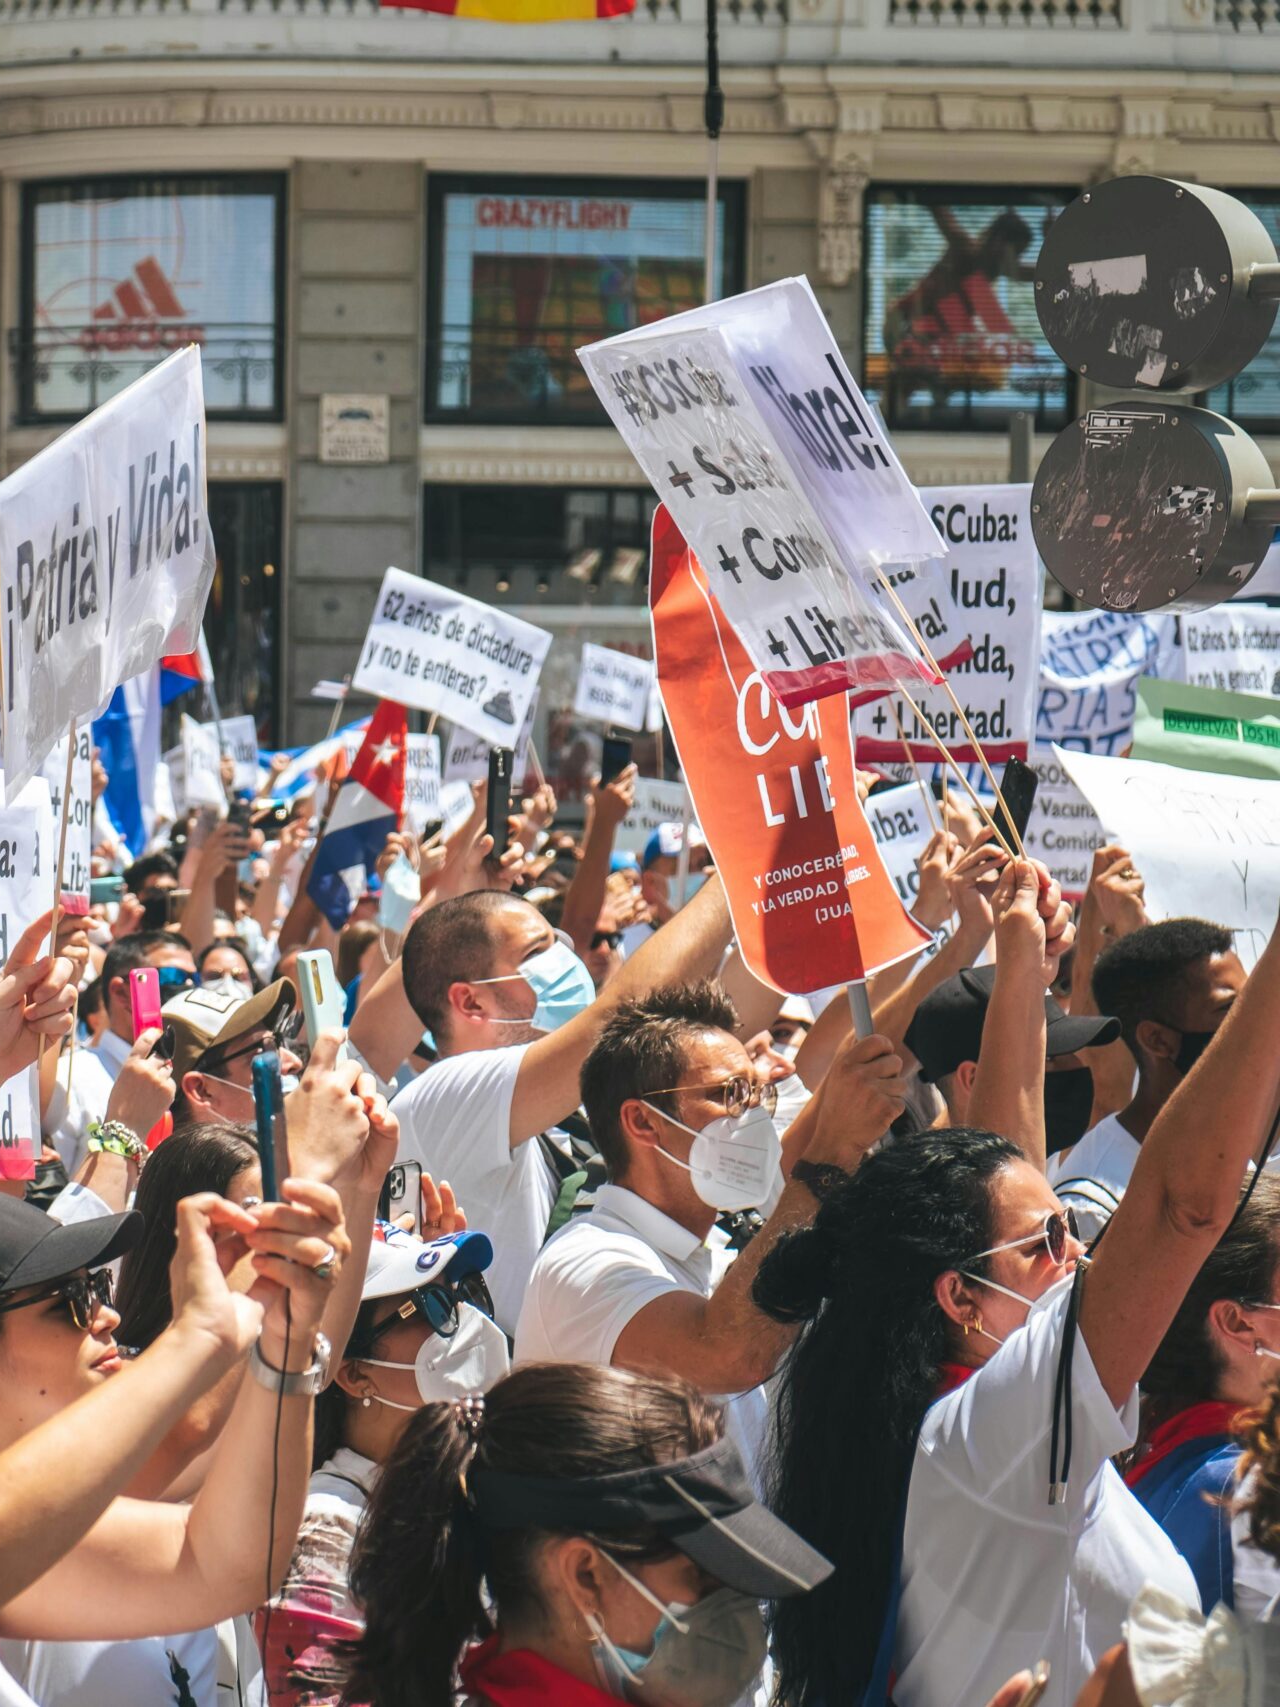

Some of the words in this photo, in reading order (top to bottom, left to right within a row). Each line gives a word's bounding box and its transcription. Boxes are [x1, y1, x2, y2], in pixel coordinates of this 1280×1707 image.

[104, 507, 121, 637] y
[128, 423, 200, 580] Vida!
[383, 589, 405, 622] 62
[403, 600, 440, 637] años
[444, 615, 466, 644] de
[466, 626, 534, 677] dictadura
[362, 640, 376, 669] y
[380, 643, 402, 671] no
[404, 648, 421, 677] te
[422, 654, 488, 702] enteras?
[897, 699, 1013, 740] Libertad.
[751, 902, 759, 916] Y
[760, 895, 777, 914] LA
[777, 881, 839, 908] VERDAD
[753, 875, 762, 889] Y
